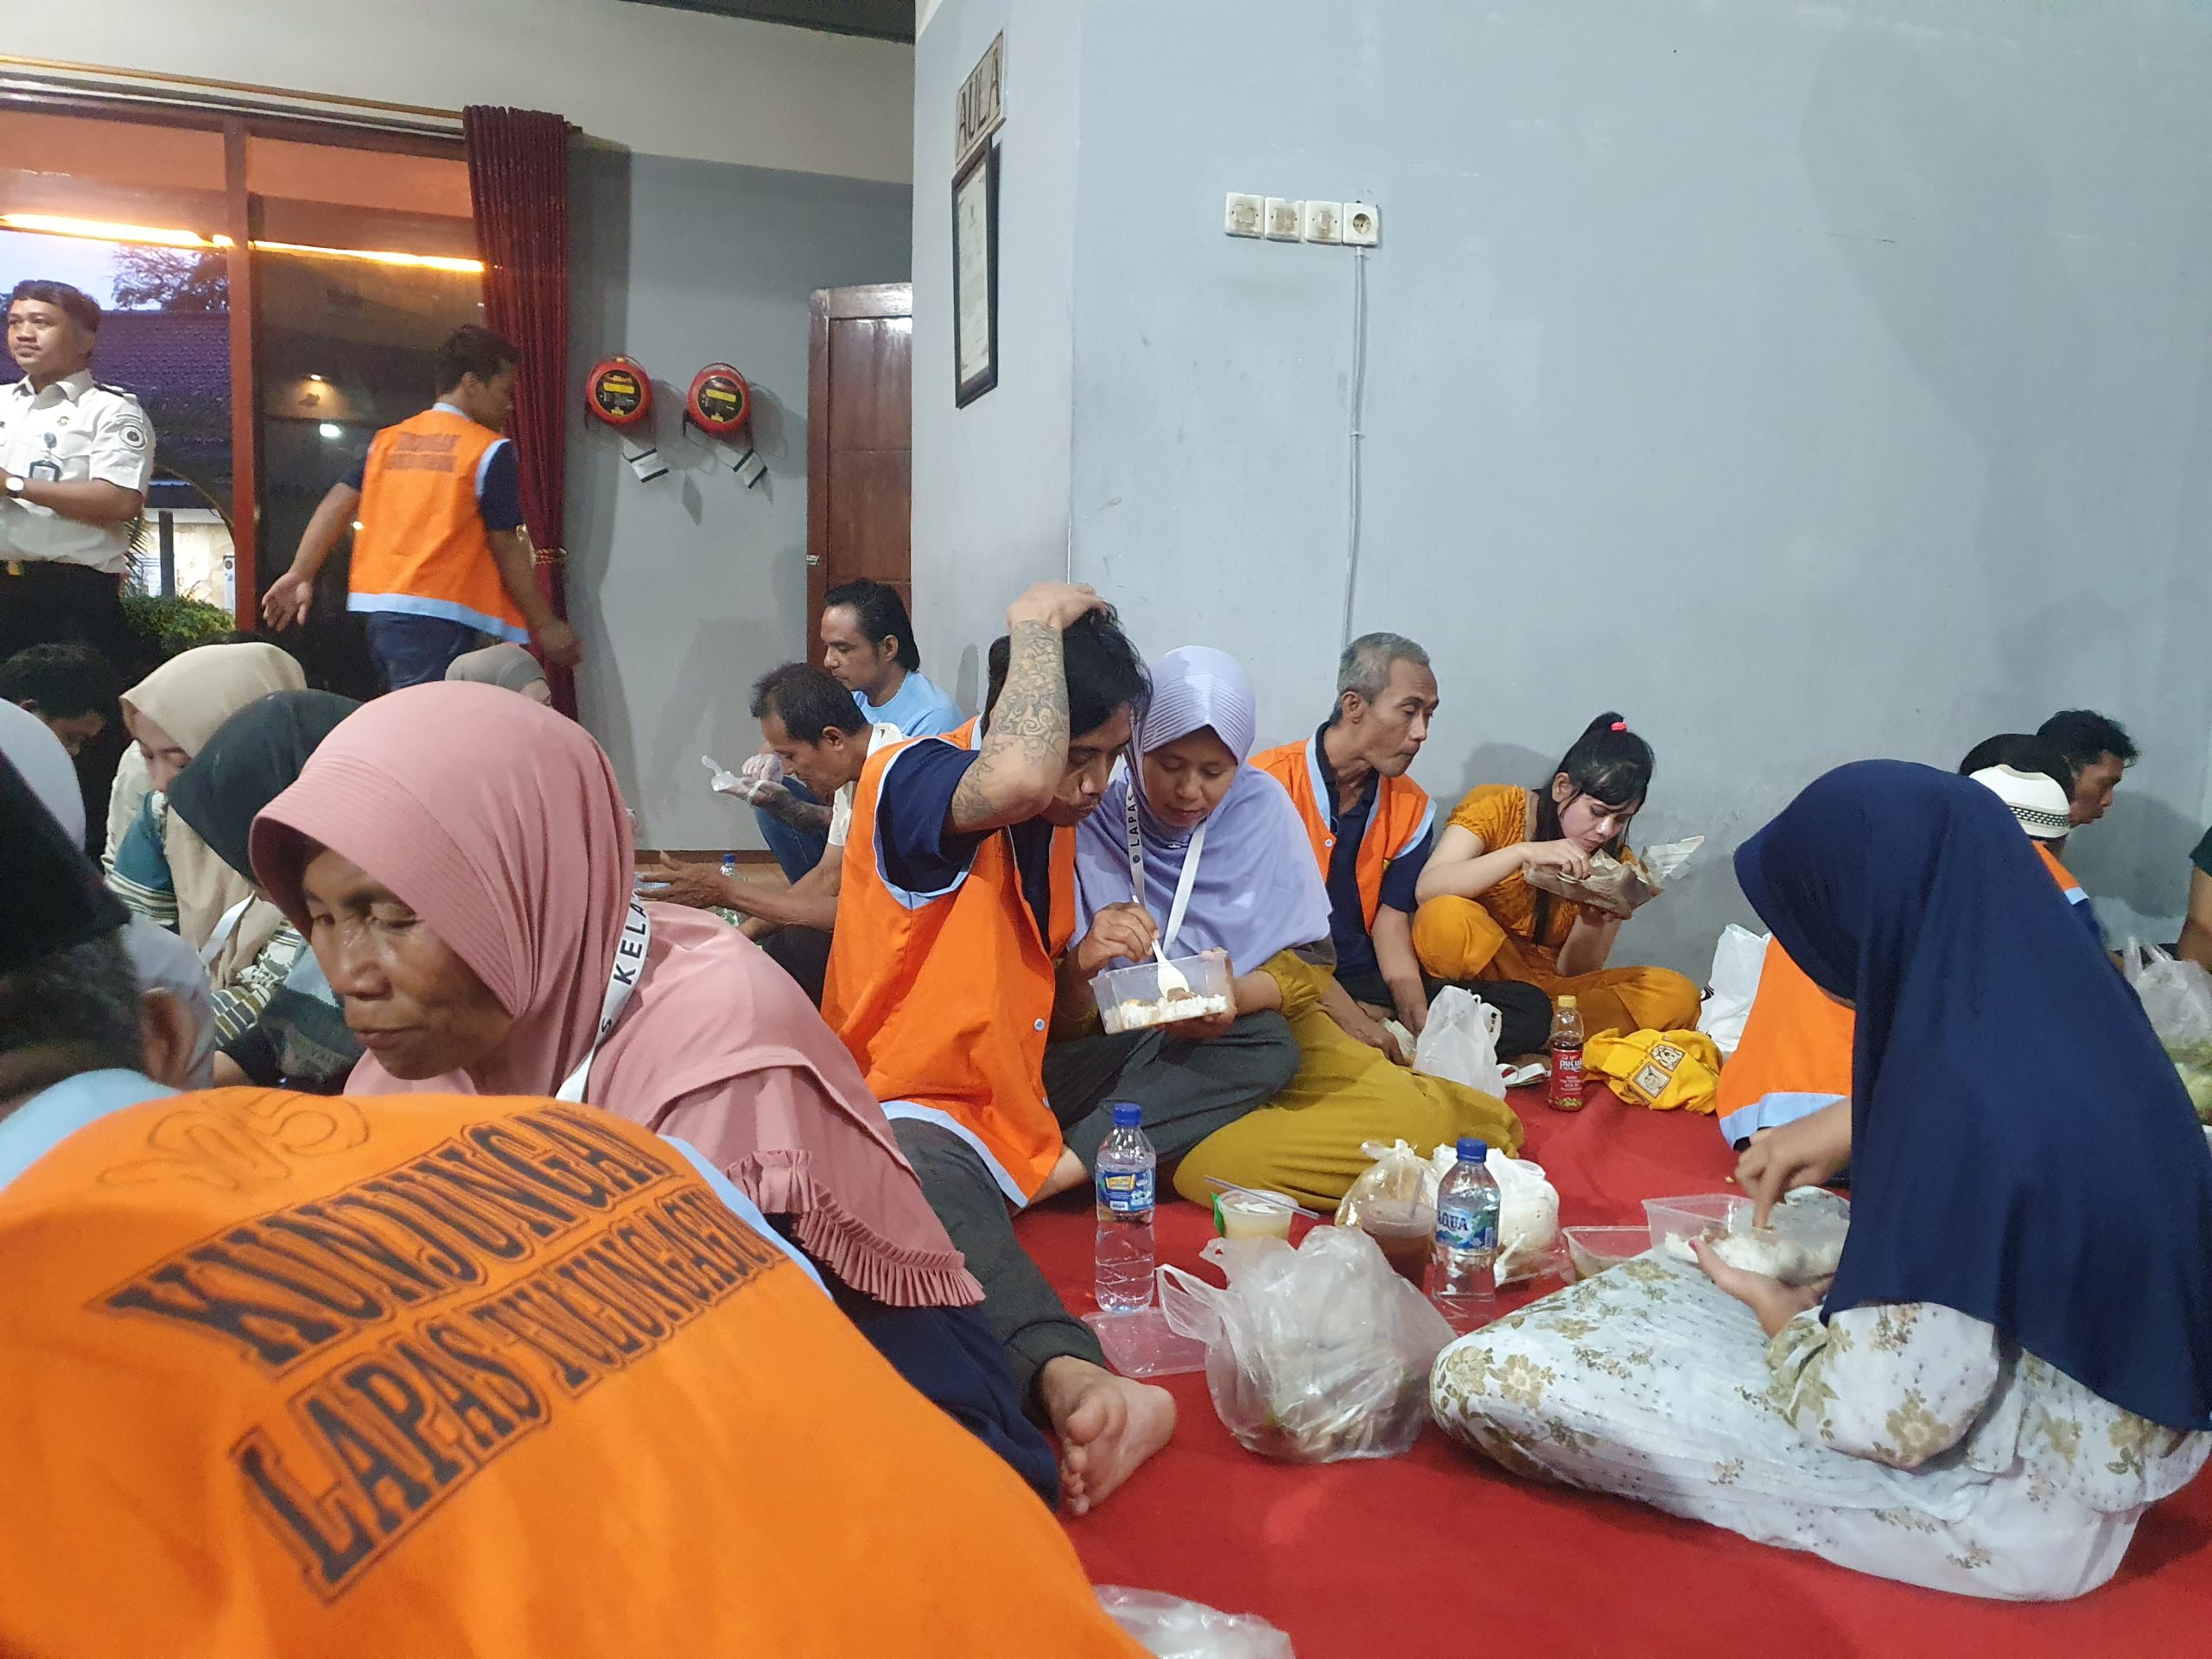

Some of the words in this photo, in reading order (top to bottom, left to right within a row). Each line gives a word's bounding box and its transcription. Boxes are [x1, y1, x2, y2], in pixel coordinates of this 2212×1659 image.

[958, 47, 1000, 154] AULA
[613, 899, 646, 986] KELA
[91, 1105, 679, 1374] KUNJUNGAN
[232, 1315, 550, 1599] LAPAS
